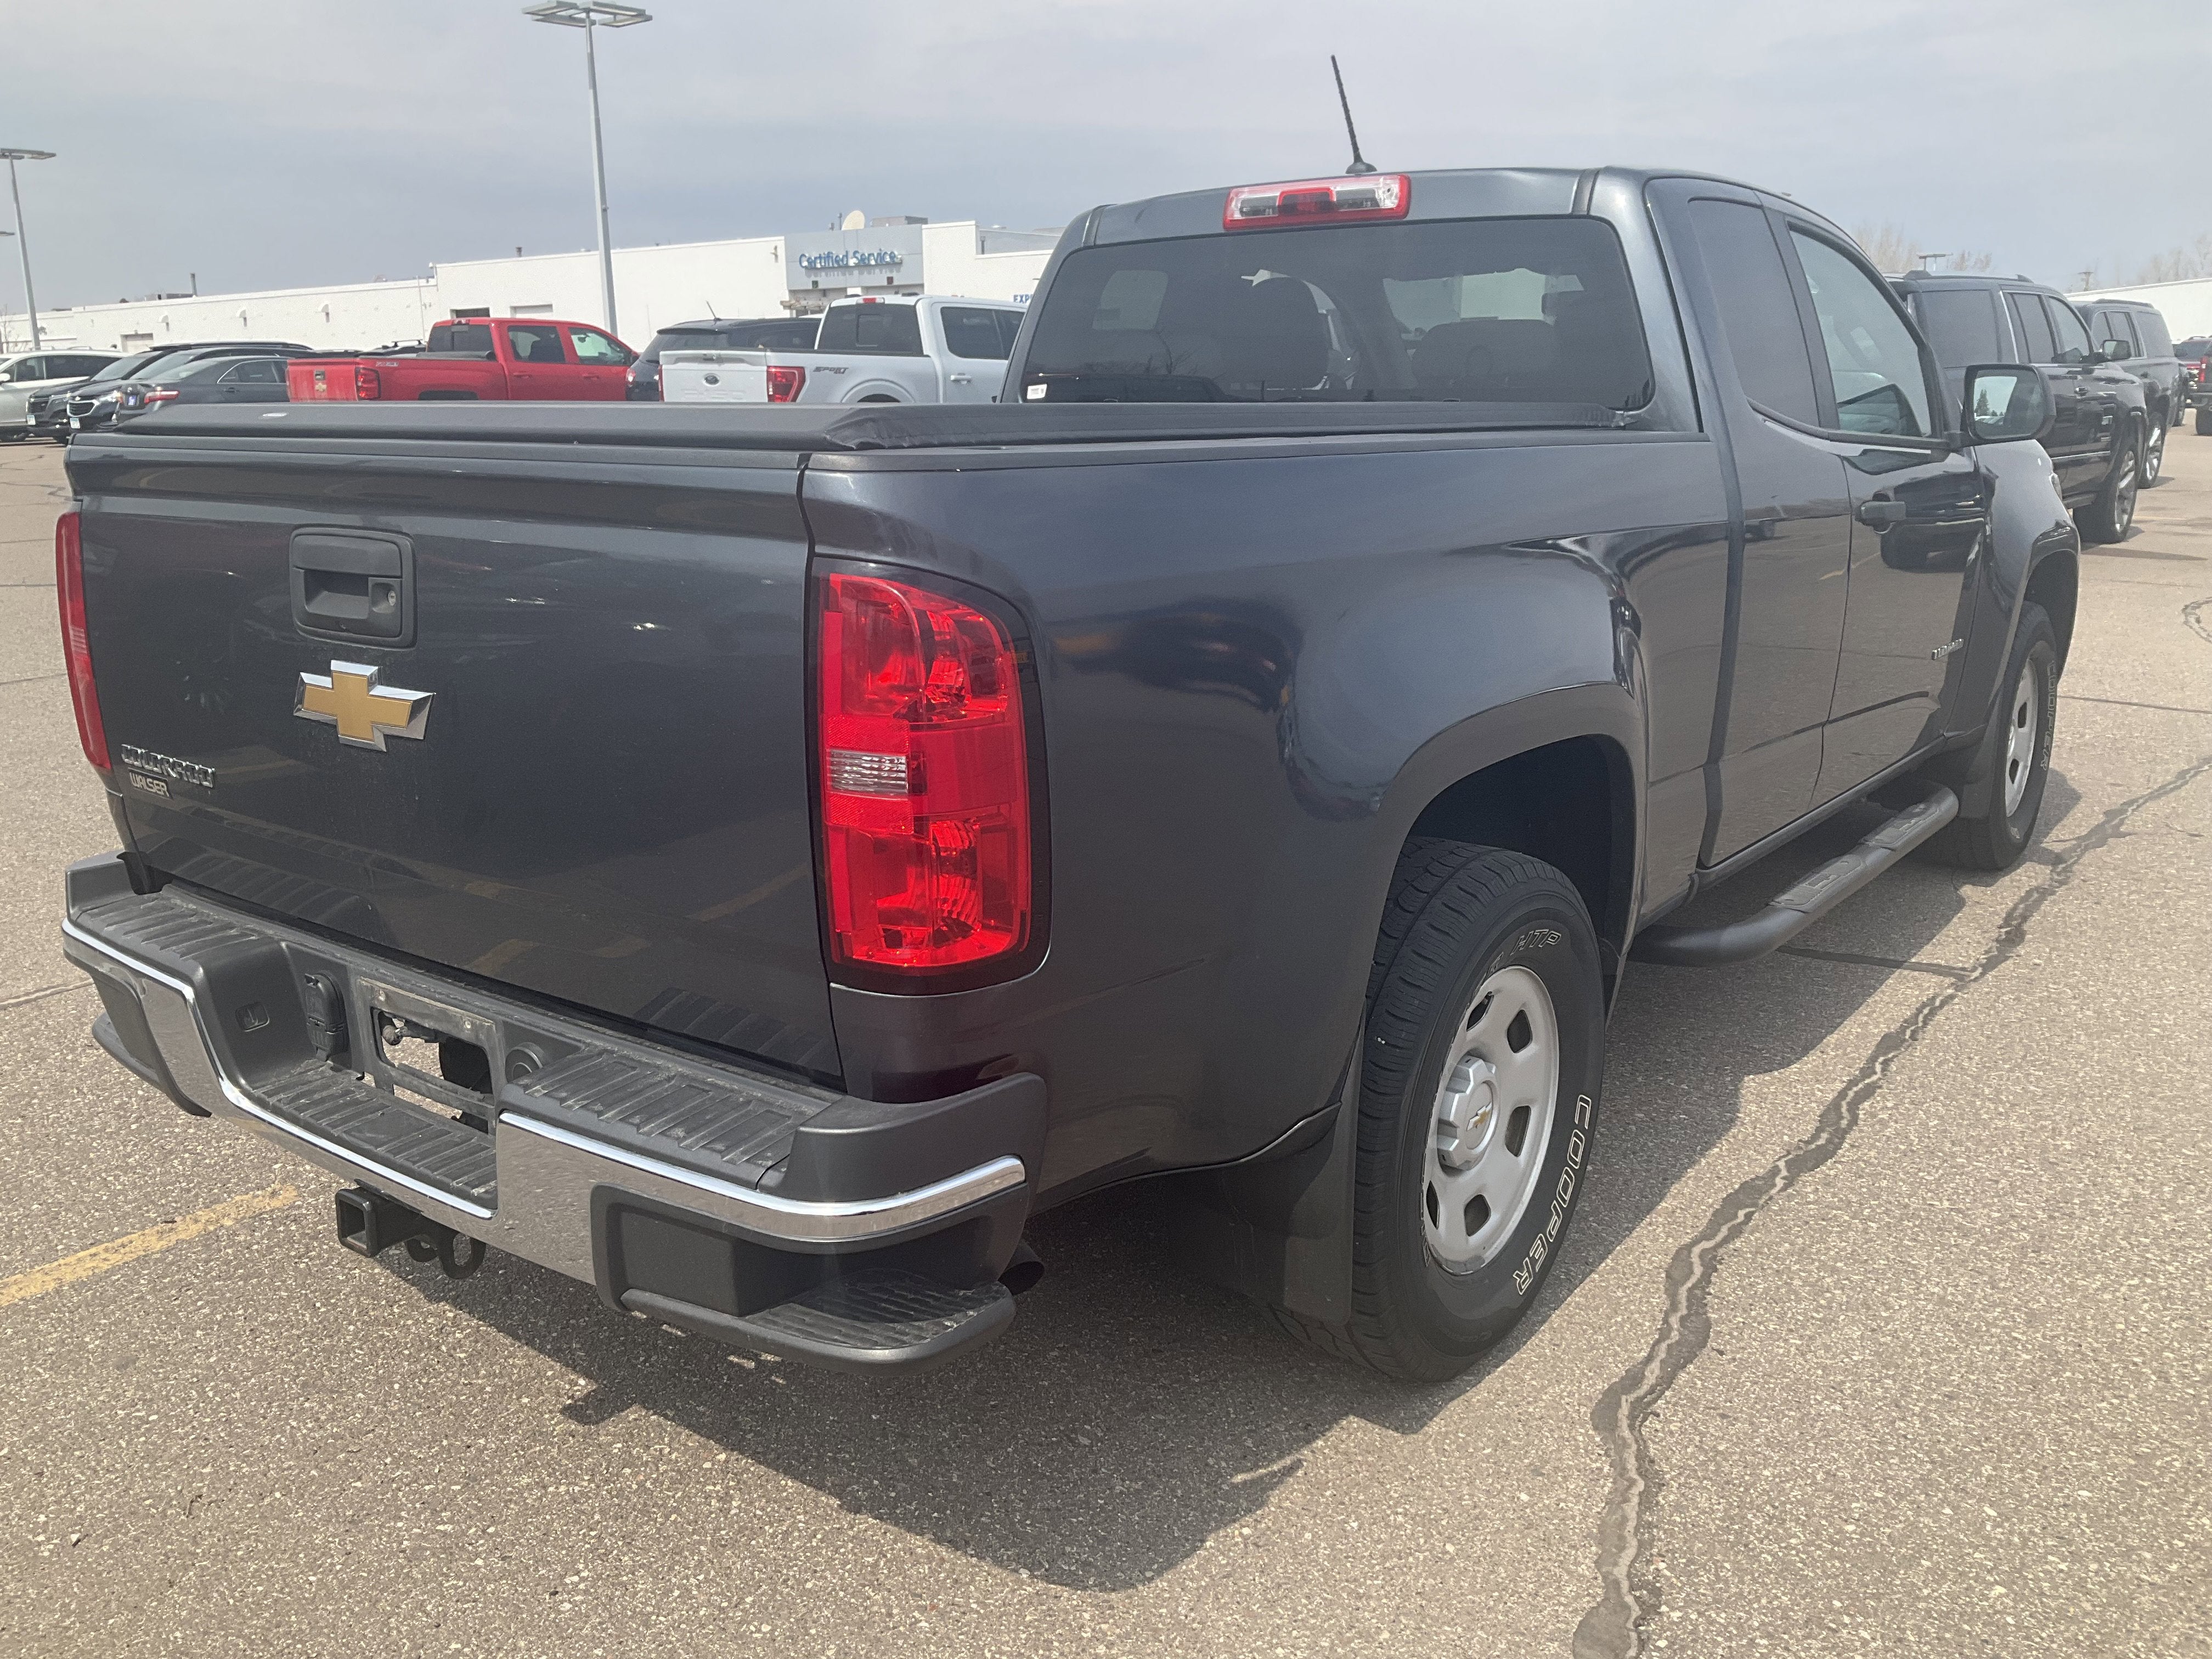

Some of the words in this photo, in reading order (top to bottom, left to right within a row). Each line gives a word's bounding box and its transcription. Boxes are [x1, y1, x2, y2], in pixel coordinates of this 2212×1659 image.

[799, 250, 849, 269] Certified
[853, 248, 896, 266] Service
[1013, 294, 1034, 304] EXP
[120, 743, 216, 789] COLORADO
[128, 771, 171, 797] WALSER
[1510, 928, 1562, 956] HTP
[1513, 1094, 1592, 1295] COOPER
